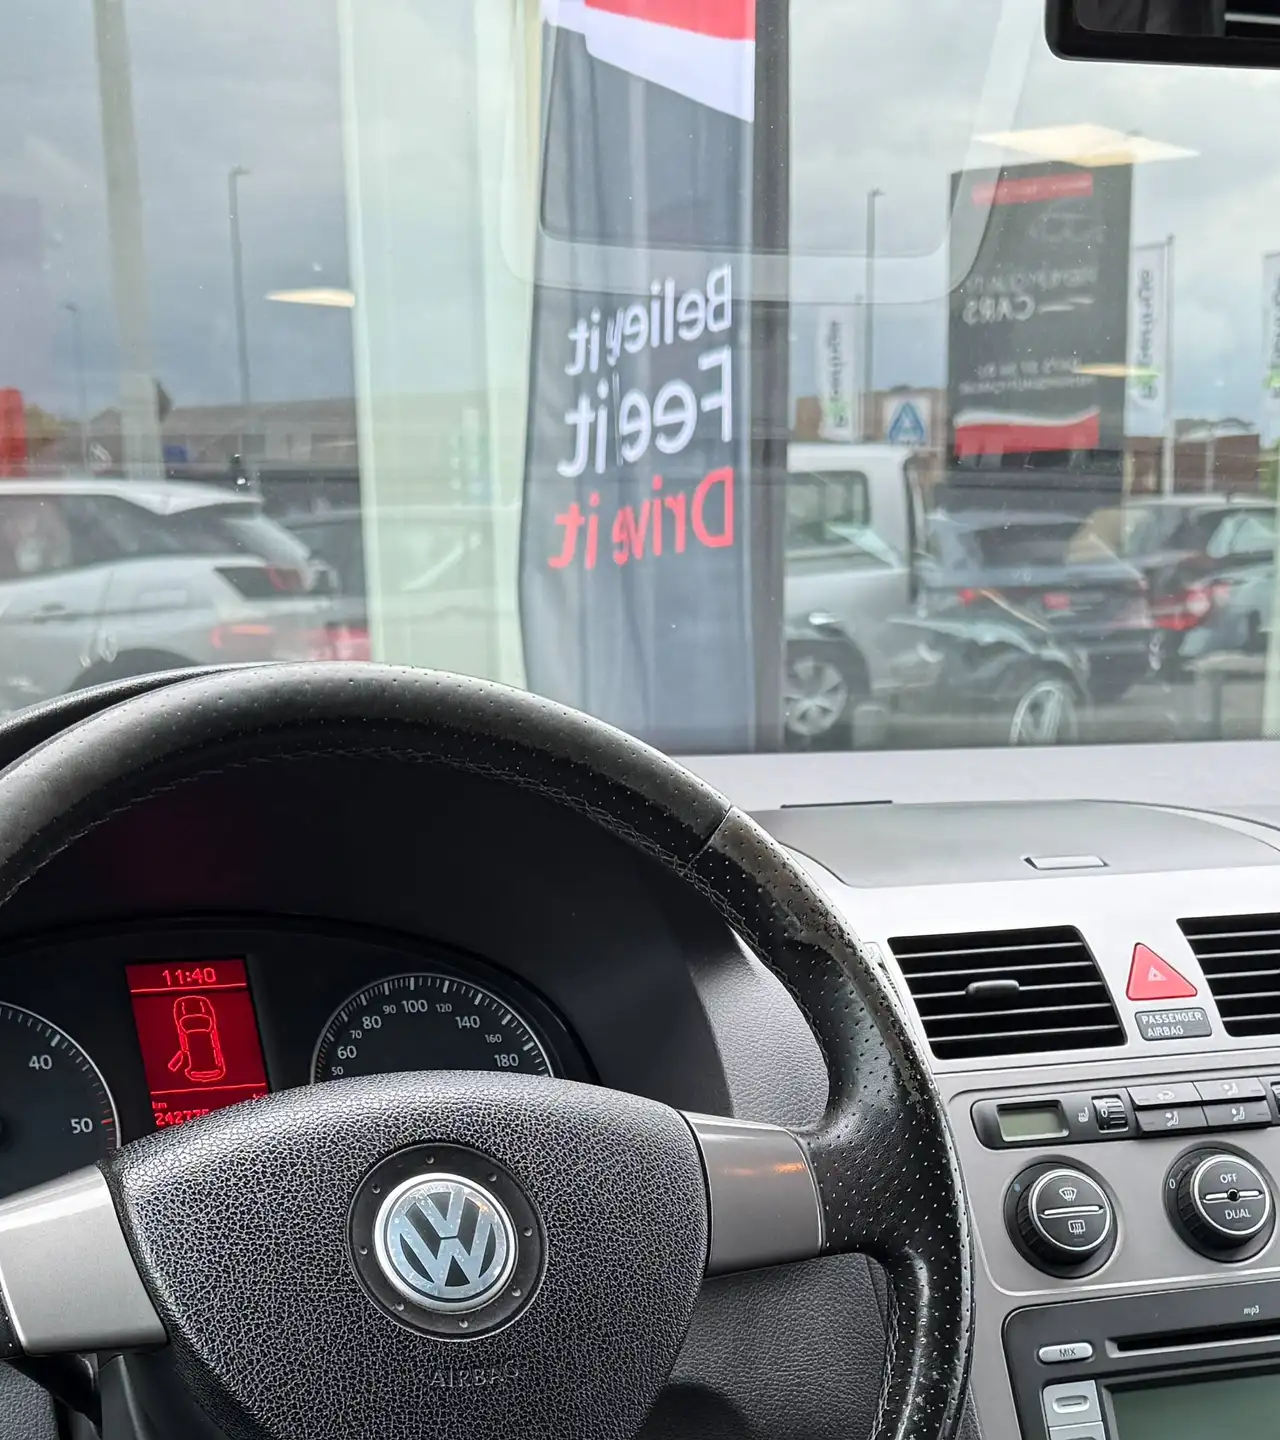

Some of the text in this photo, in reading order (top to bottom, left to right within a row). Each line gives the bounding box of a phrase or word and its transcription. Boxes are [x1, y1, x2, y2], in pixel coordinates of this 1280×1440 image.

[162, 967, 217, 986] 11:40
[382, 1004, 397, 1015] 90
[402, 999, 428, 1013] 100
[435, 1003, 453, 1013] 120
[362, 1015, 382, 1030] 80
[455, 1015, 481, 1030] 140
[1141, 1011, 1204, 1025] PASSENGER
[349, 1029, 363, 1040] 70
[1147, 1025, 1185, 1038] AIRBAG
[485, 1033, 503, 1044] 160
[337, 1045, 358, 1060] 60
[28, 1054, 53, 1070] 40
[494, 1053, 520, 1068] 180
[331, 1066, 345, 1076] 50
[70, 1117, 94, 1134] 50
[1220, 1173, 1238, 1184] OFF
[1224, 1208, 1252, 1221] DUAL
[1243, 1305, 1260, 1316] mp3
[1059, 1346, 1077, 1358] MIX
[429, 1360, 520, 1389] AIRBAG
